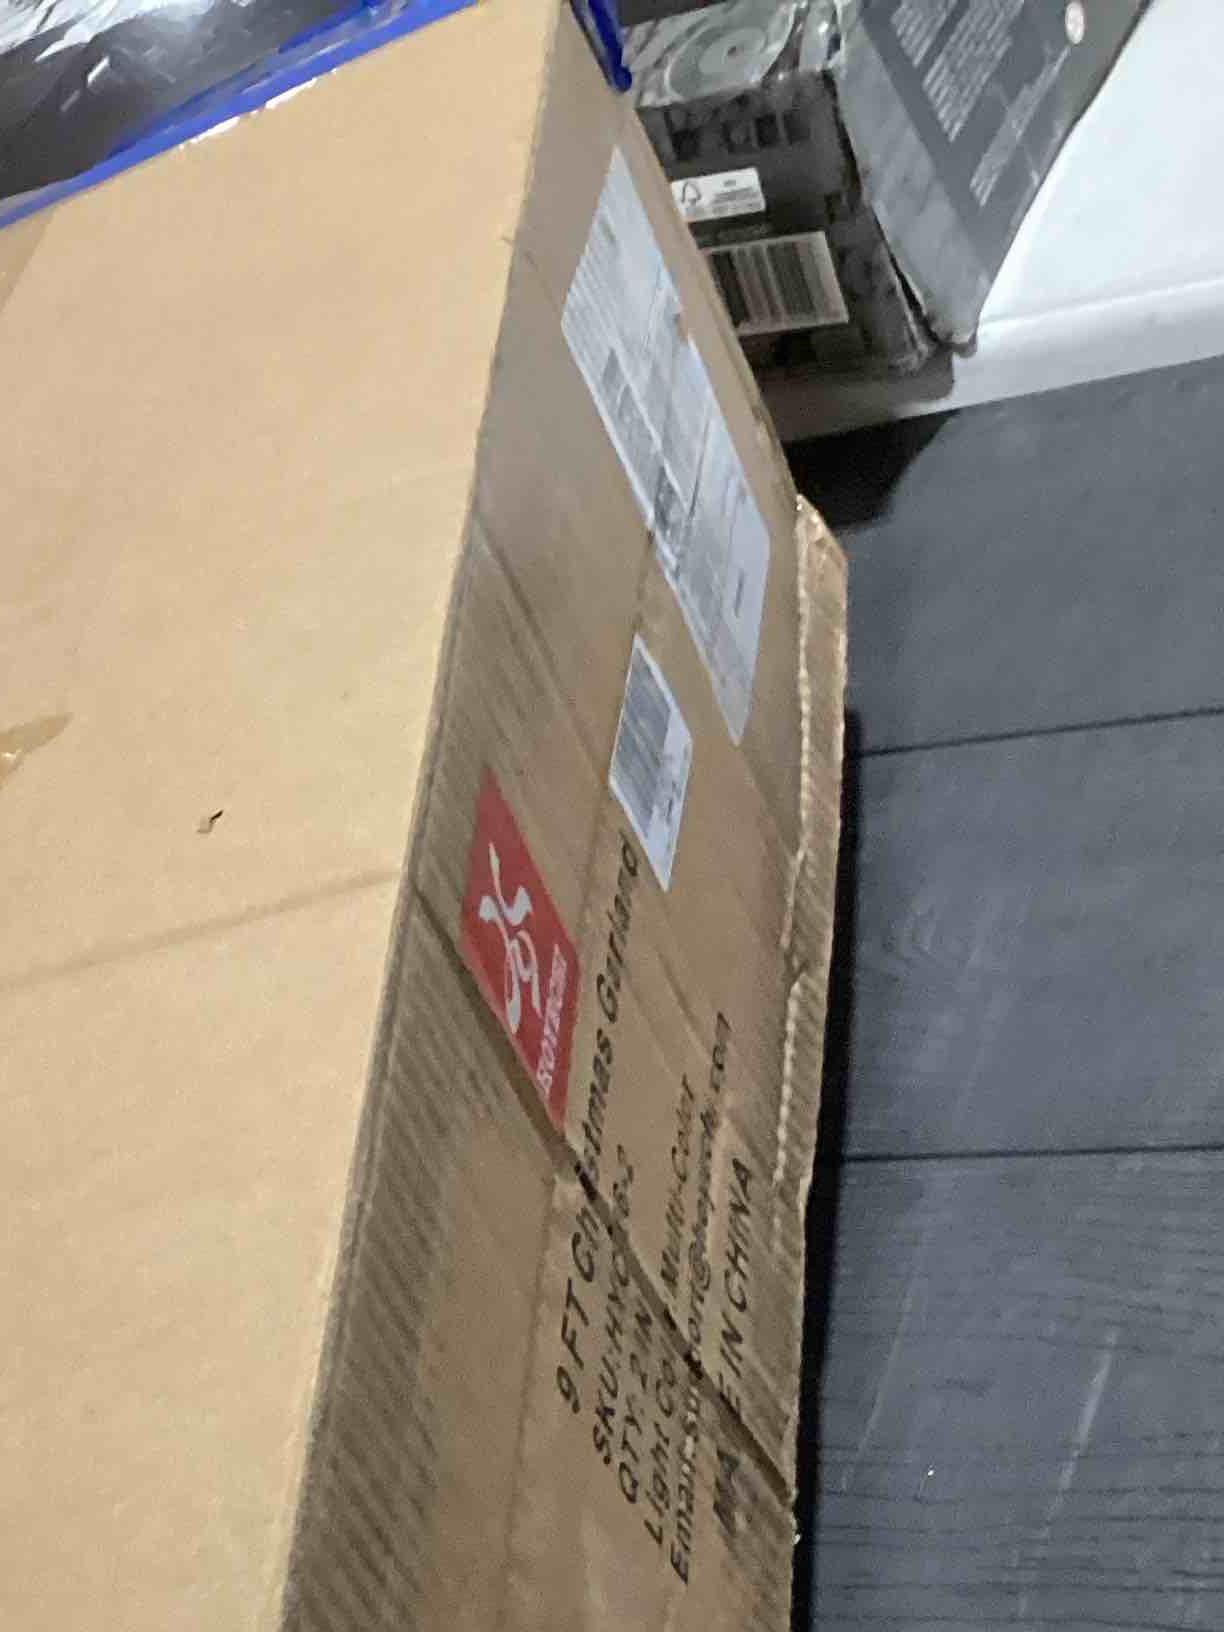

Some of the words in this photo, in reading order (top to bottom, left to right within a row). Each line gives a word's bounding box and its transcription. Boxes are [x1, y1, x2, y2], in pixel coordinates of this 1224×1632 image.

[597, 829, 639, 1024] Garland
[572, 1027, 612, 1282] Chstmas
[724, 1157, 752, 1313] CHINA
[556, 1366, 581, 1414] 9
[561, 1277, 589, 1369] FT
[720, 1311, 743, 1379] IN
[644, 1422, 670, 1545] Light
[713, 1371, 743, 1528] MAE
